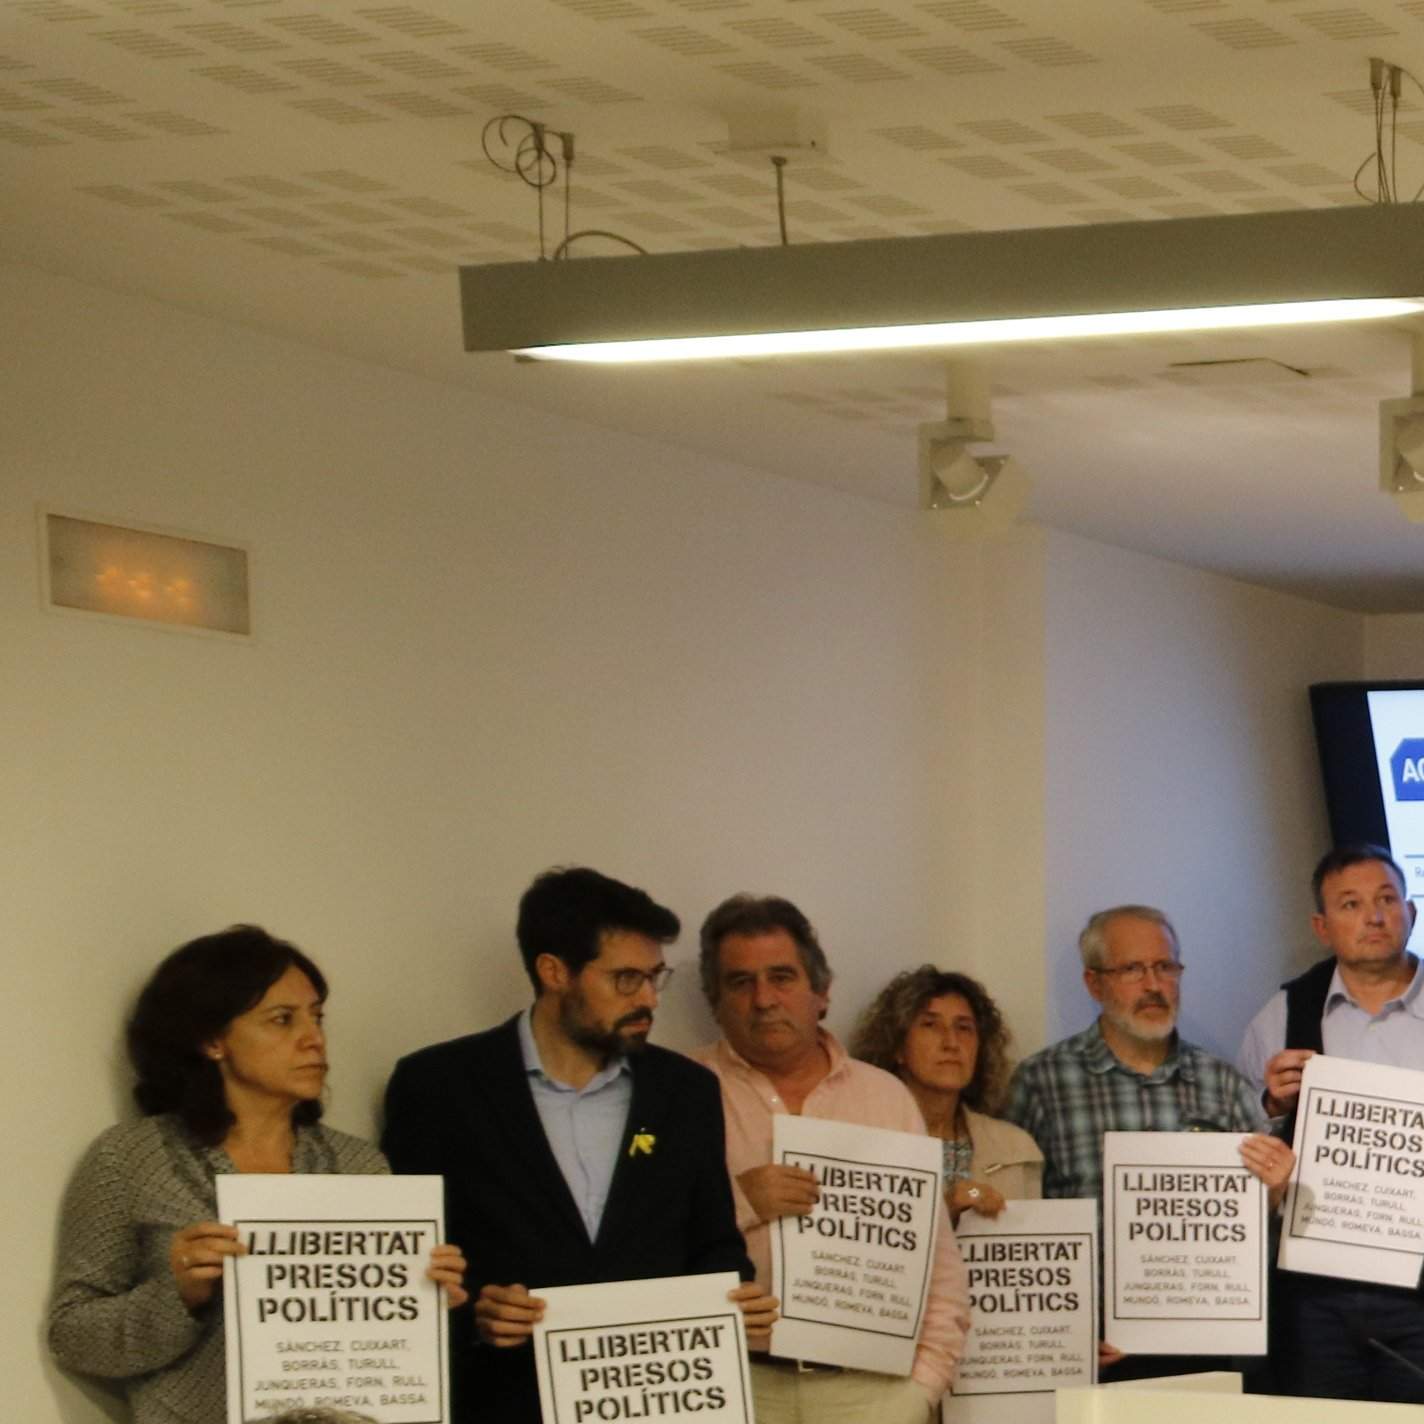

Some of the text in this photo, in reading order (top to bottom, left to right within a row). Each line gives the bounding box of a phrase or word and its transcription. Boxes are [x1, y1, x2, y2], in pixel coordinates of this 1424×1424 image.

[1325, 1122, 1424, 1153] PRESOS
[1123, 1172, 1252, 1193] LLIBERTAT
[1136, 1198, 1240, 1218] PRESOS
[248, 1230, 426, 1256] LLIBERTAT
[798, 1214, 918, 1251] POLÍTICS
[1128, 1218, 1247, 1242] POLÍTICS
[267, 1263, 409, 1289] PRESOS
[968, 1267, 1071, 1288] PRESOS
[257, 1291, 419, 1323] POLÍTICS
[559, 1324, 726, 1363] LLIBERTAT
[580, 1357, 714, 1392] PRESOS
[574, 1384, 727, 1423] POLÍTICS
